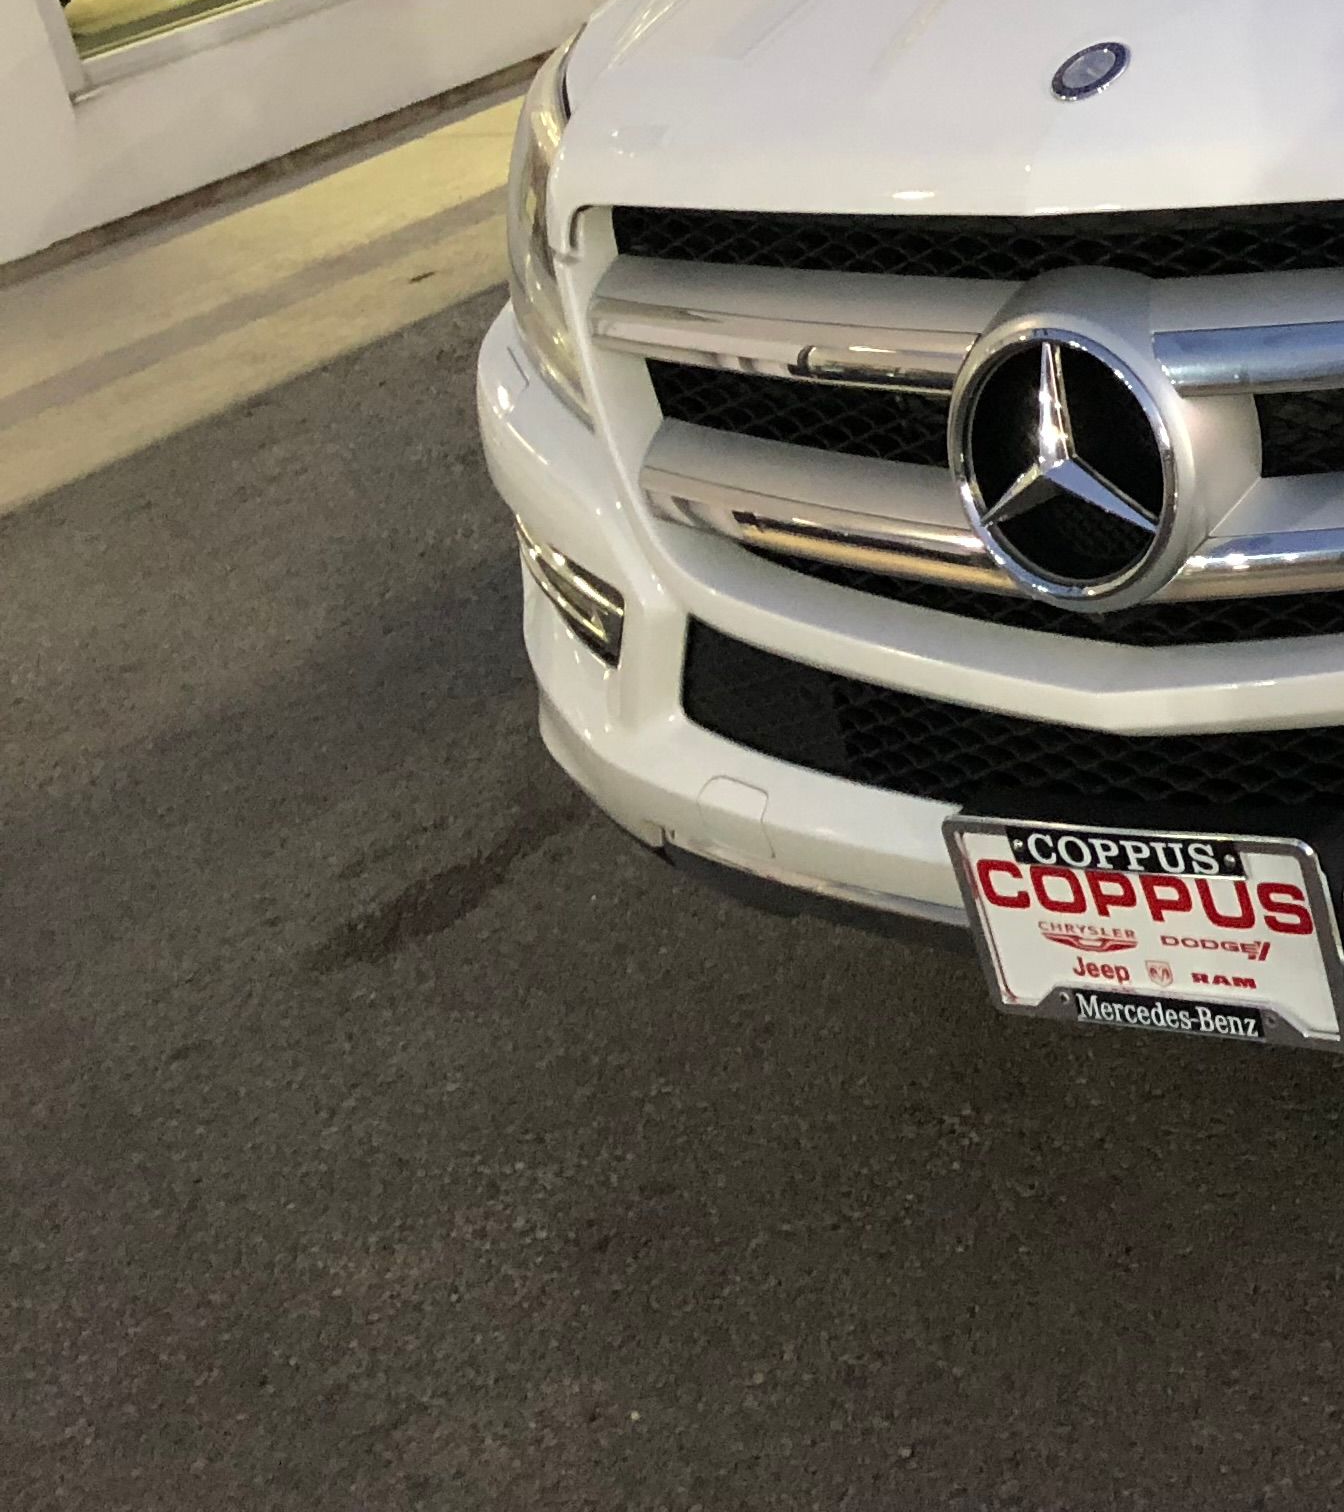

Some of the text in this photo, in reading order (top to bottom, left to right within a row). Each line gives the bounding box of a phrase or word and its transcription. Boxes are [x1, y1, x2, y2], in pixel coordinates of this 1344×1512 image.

[1026, 832, 1222, 875] COPPUS
[976, 858, 1314, 935] COPPUS
[1037, 920, 1137, 940] CHRYSLER
[1160, 935, 1262, 955] DODGE
[1072, 956, 1131, 984] Jeep
[1191, 972, 1258, 990] RAM
[1075, 992, 1260, 1038] Mercedes-Benz
